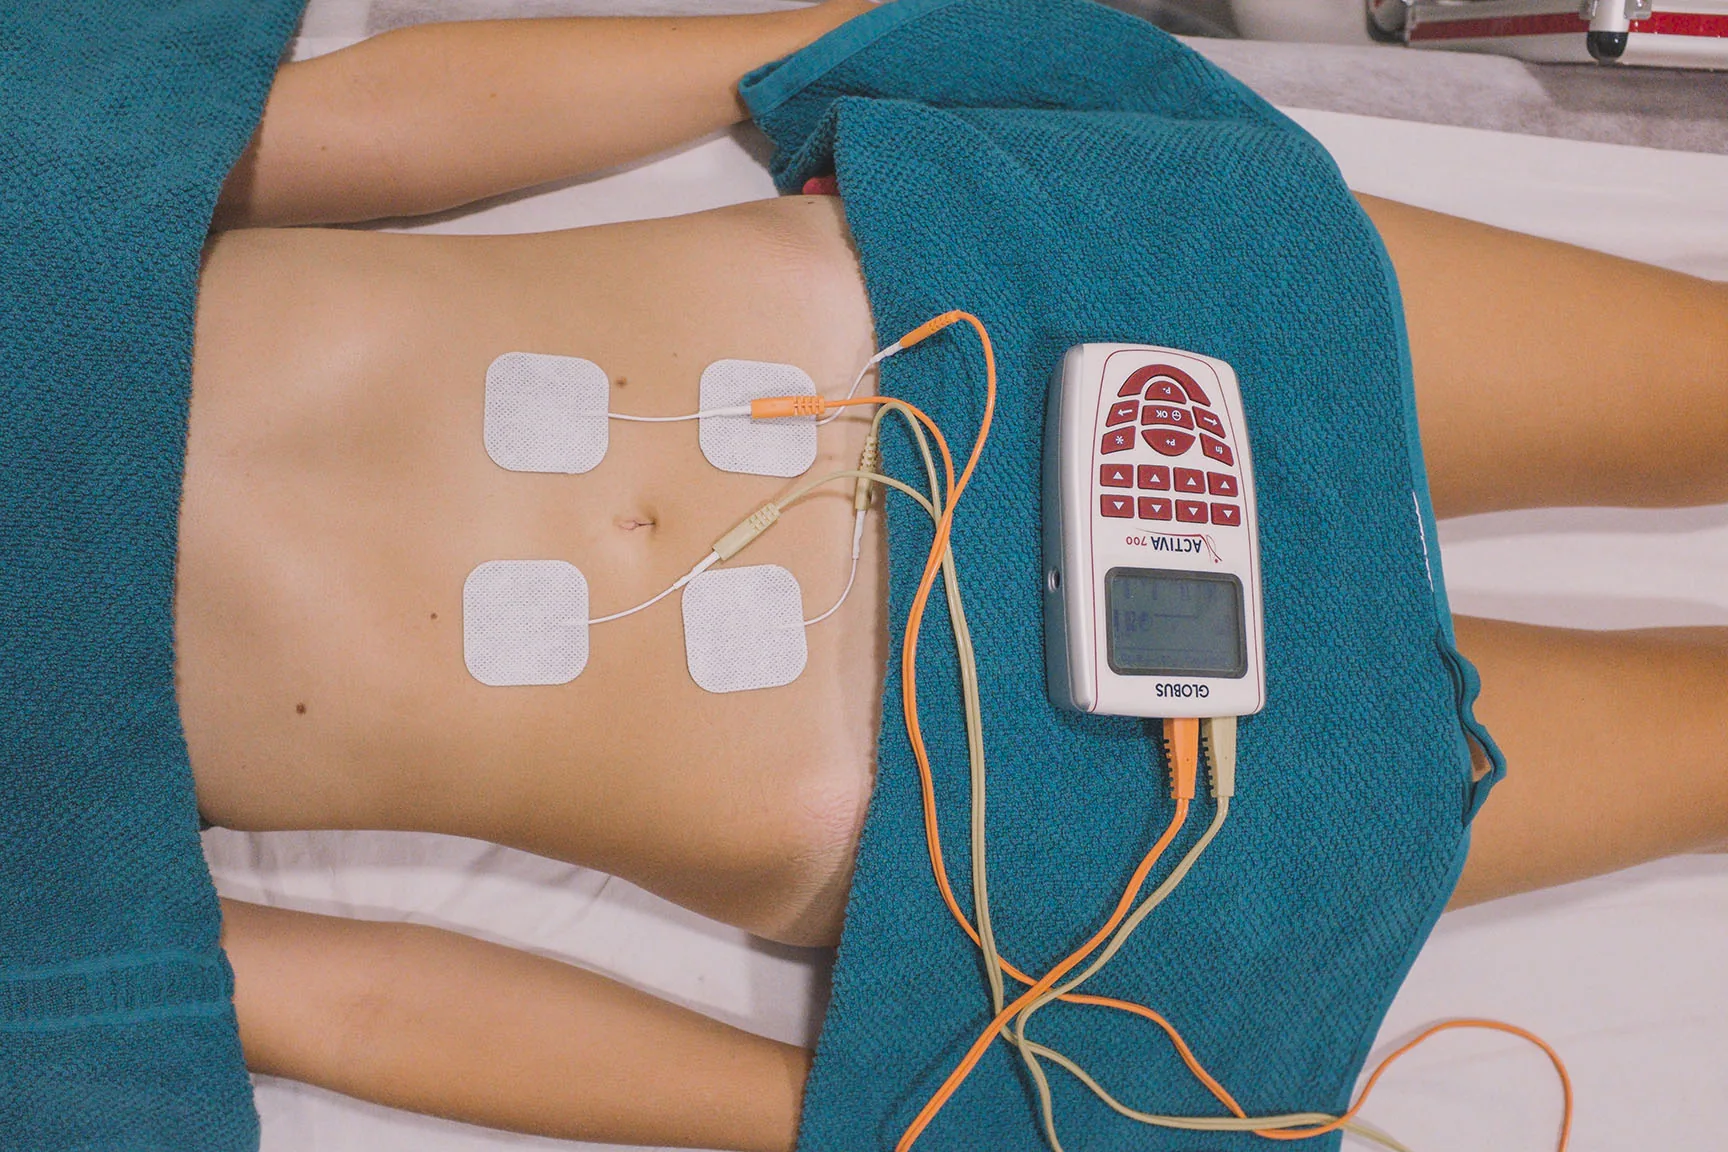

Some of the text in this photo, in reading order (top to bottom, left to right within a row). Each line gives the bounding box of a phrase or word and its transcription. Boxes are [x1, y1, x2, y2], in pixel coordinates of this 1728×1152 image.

[1156, 410, 1168, 418] OK
[1125, 535, 1202, 553] ACTIVA 700
[1155, 683, 1210, 698] GLOBUS
